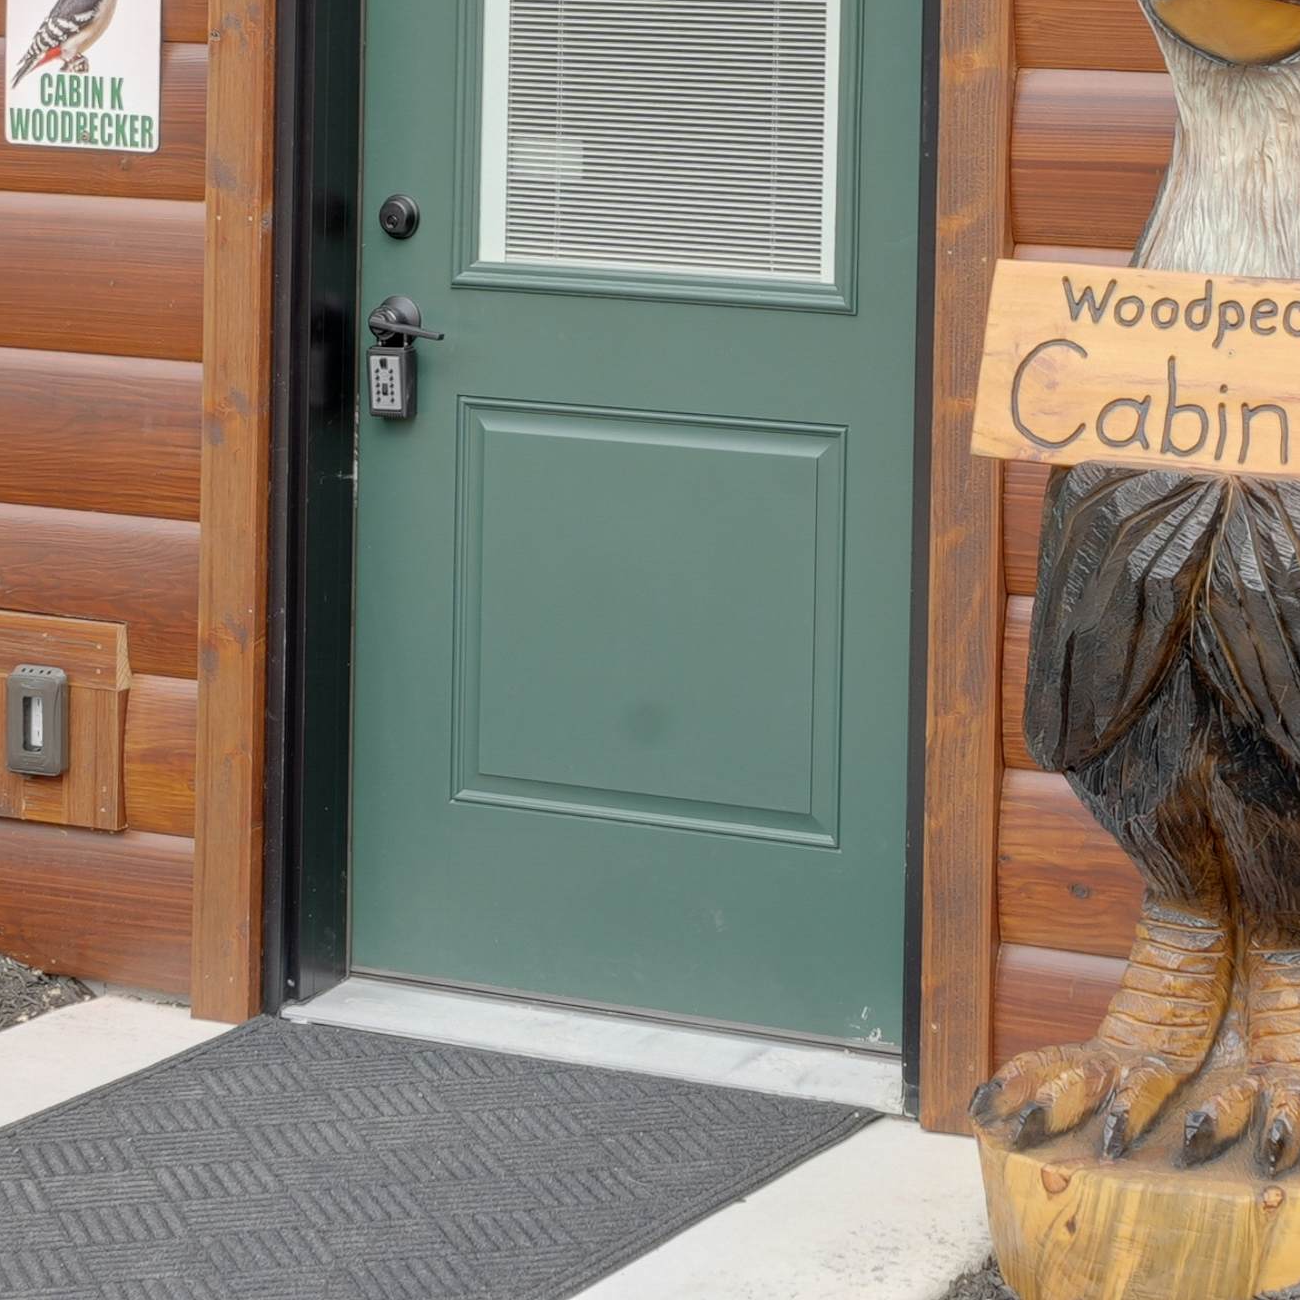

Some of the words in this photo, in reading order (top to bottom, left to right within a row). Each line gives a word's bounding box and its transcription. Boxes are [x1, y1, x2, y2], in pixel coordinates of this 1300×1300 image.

[40, 73, 104, 110] CABIN
[110, 77, 124, 111] K
[9, 107, 154, 149] WOODPECKER
[1010, 338, 1289, 465] Cabin
